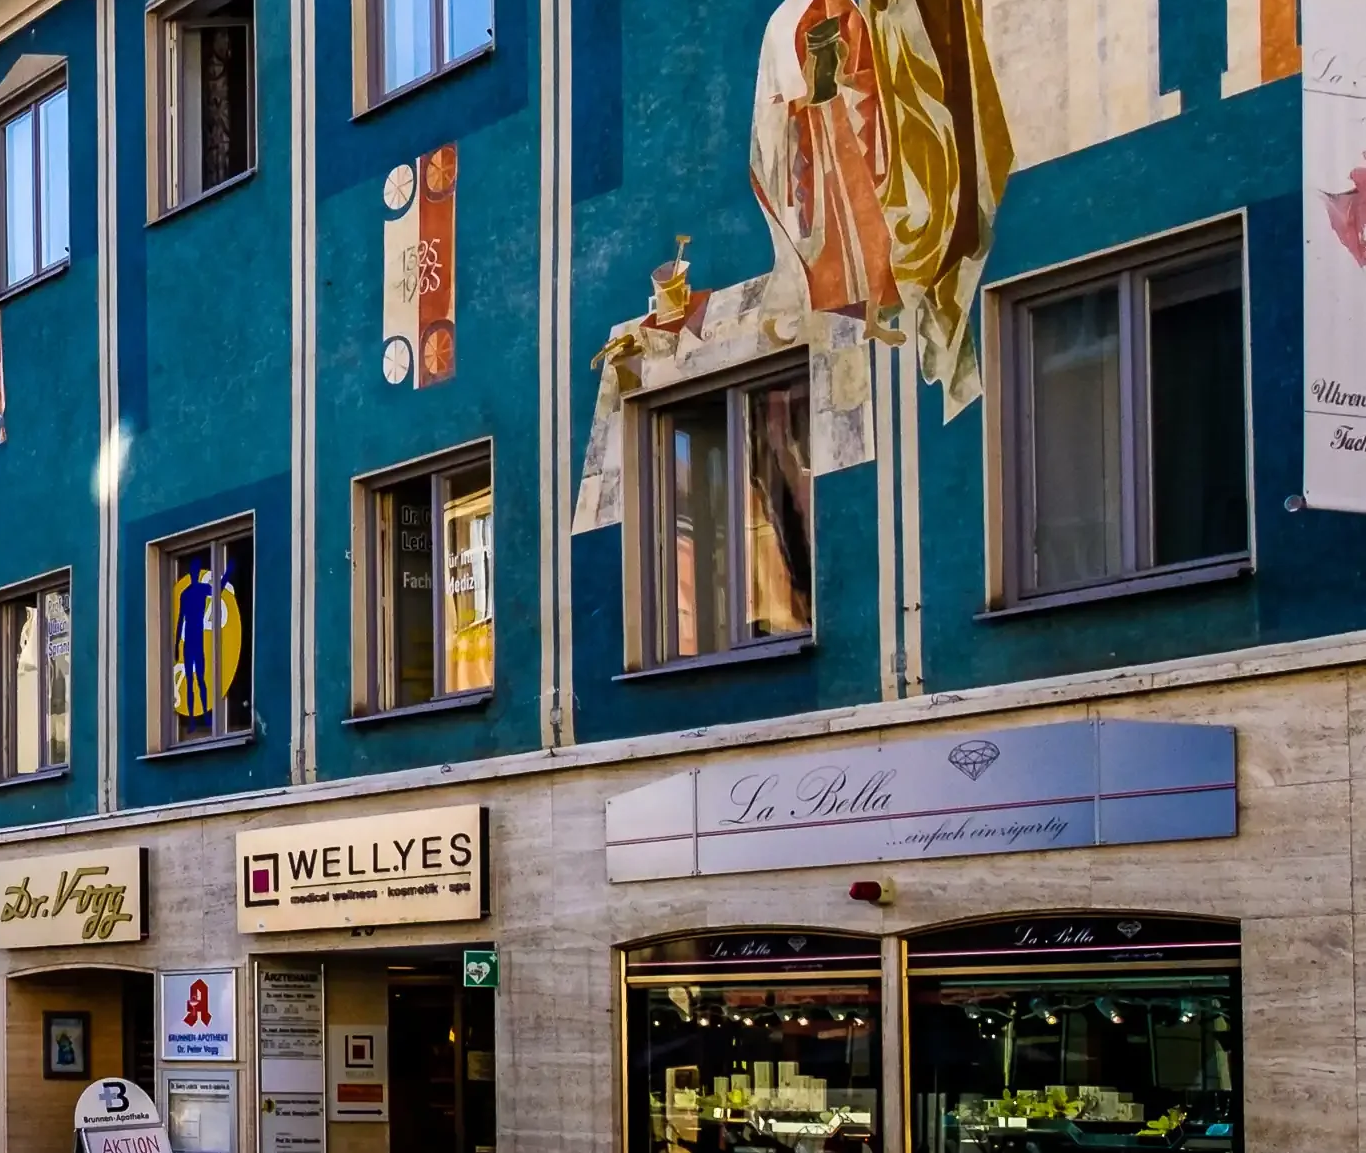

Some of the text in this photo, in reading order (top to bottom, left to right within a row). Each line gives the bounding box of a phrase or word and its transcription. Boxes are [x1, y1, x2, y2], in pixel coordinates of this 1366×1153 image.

[719, 765, 898, 826] La Bella
[287, 832, 472, 881] WELL.YES
[0, 865, 133, 940] Dr. Vogg
[83, 1111, 150, 1124] Brunnen-Apotheke
[101, 1134, 161, 1153] AKTION
